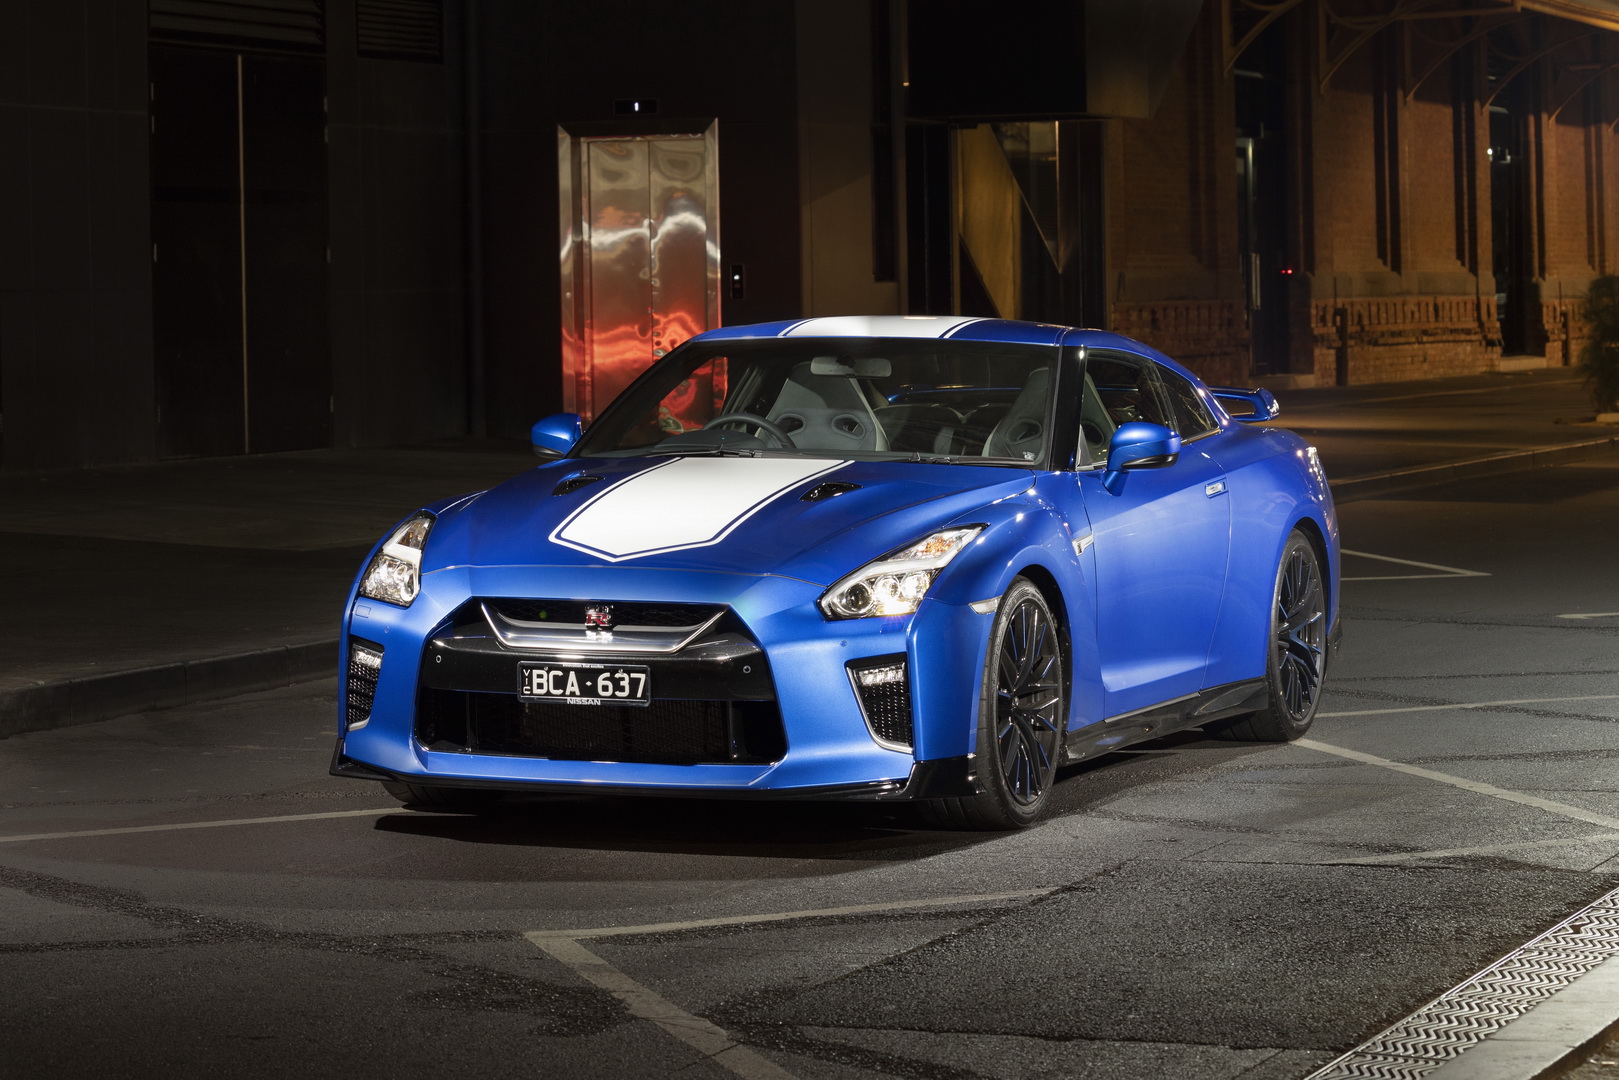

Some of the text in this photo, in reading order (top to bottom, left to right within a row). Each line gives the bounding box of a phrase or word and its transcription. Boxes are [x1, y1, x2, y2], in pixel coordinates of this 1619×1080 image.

[634, 102, 639, 112] 1
[523, 669, 531, 694] VIC
[566, 698, 601, 706] NISSAN
